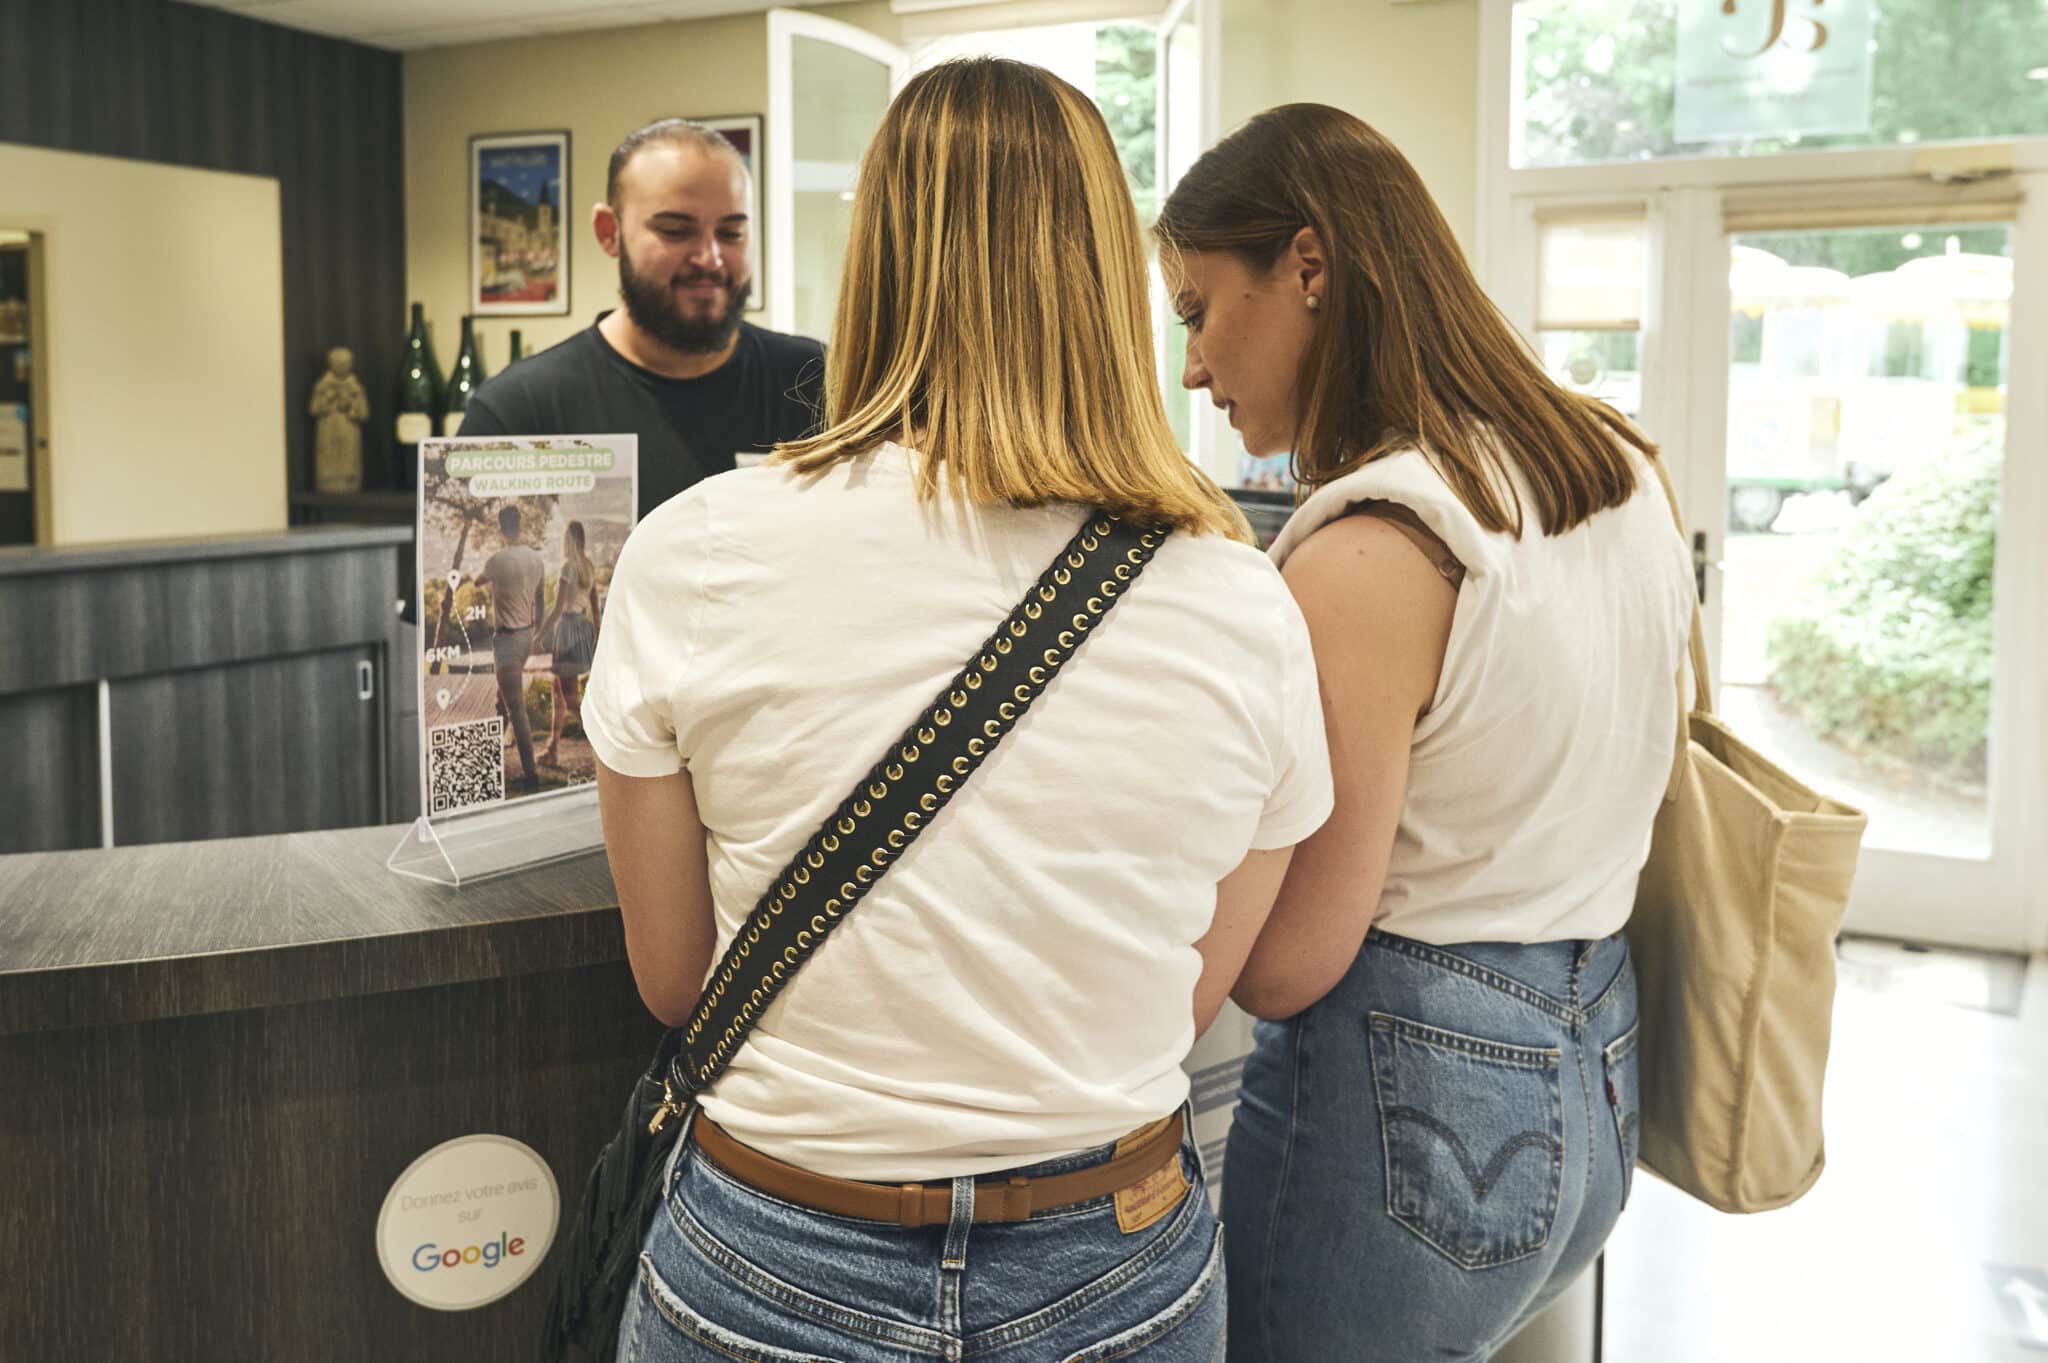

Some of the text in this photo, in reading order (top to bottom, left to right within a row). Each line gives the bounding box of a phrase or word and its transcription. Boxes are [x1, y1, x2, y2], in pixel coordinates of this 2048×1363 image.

[449, 452, 612, 471] PARCOURS PEDESTRE
[474, 475, 592, 492] WALKING ROUTE
[466, 605, 486, 621] 2H
[426, 645, 461, 663] 6KM
[401, 1178, 538, 1211] Donnez votre avis
[457, 1208, 483, 1224] sur
[412, 1231, 526, 1273] Google
